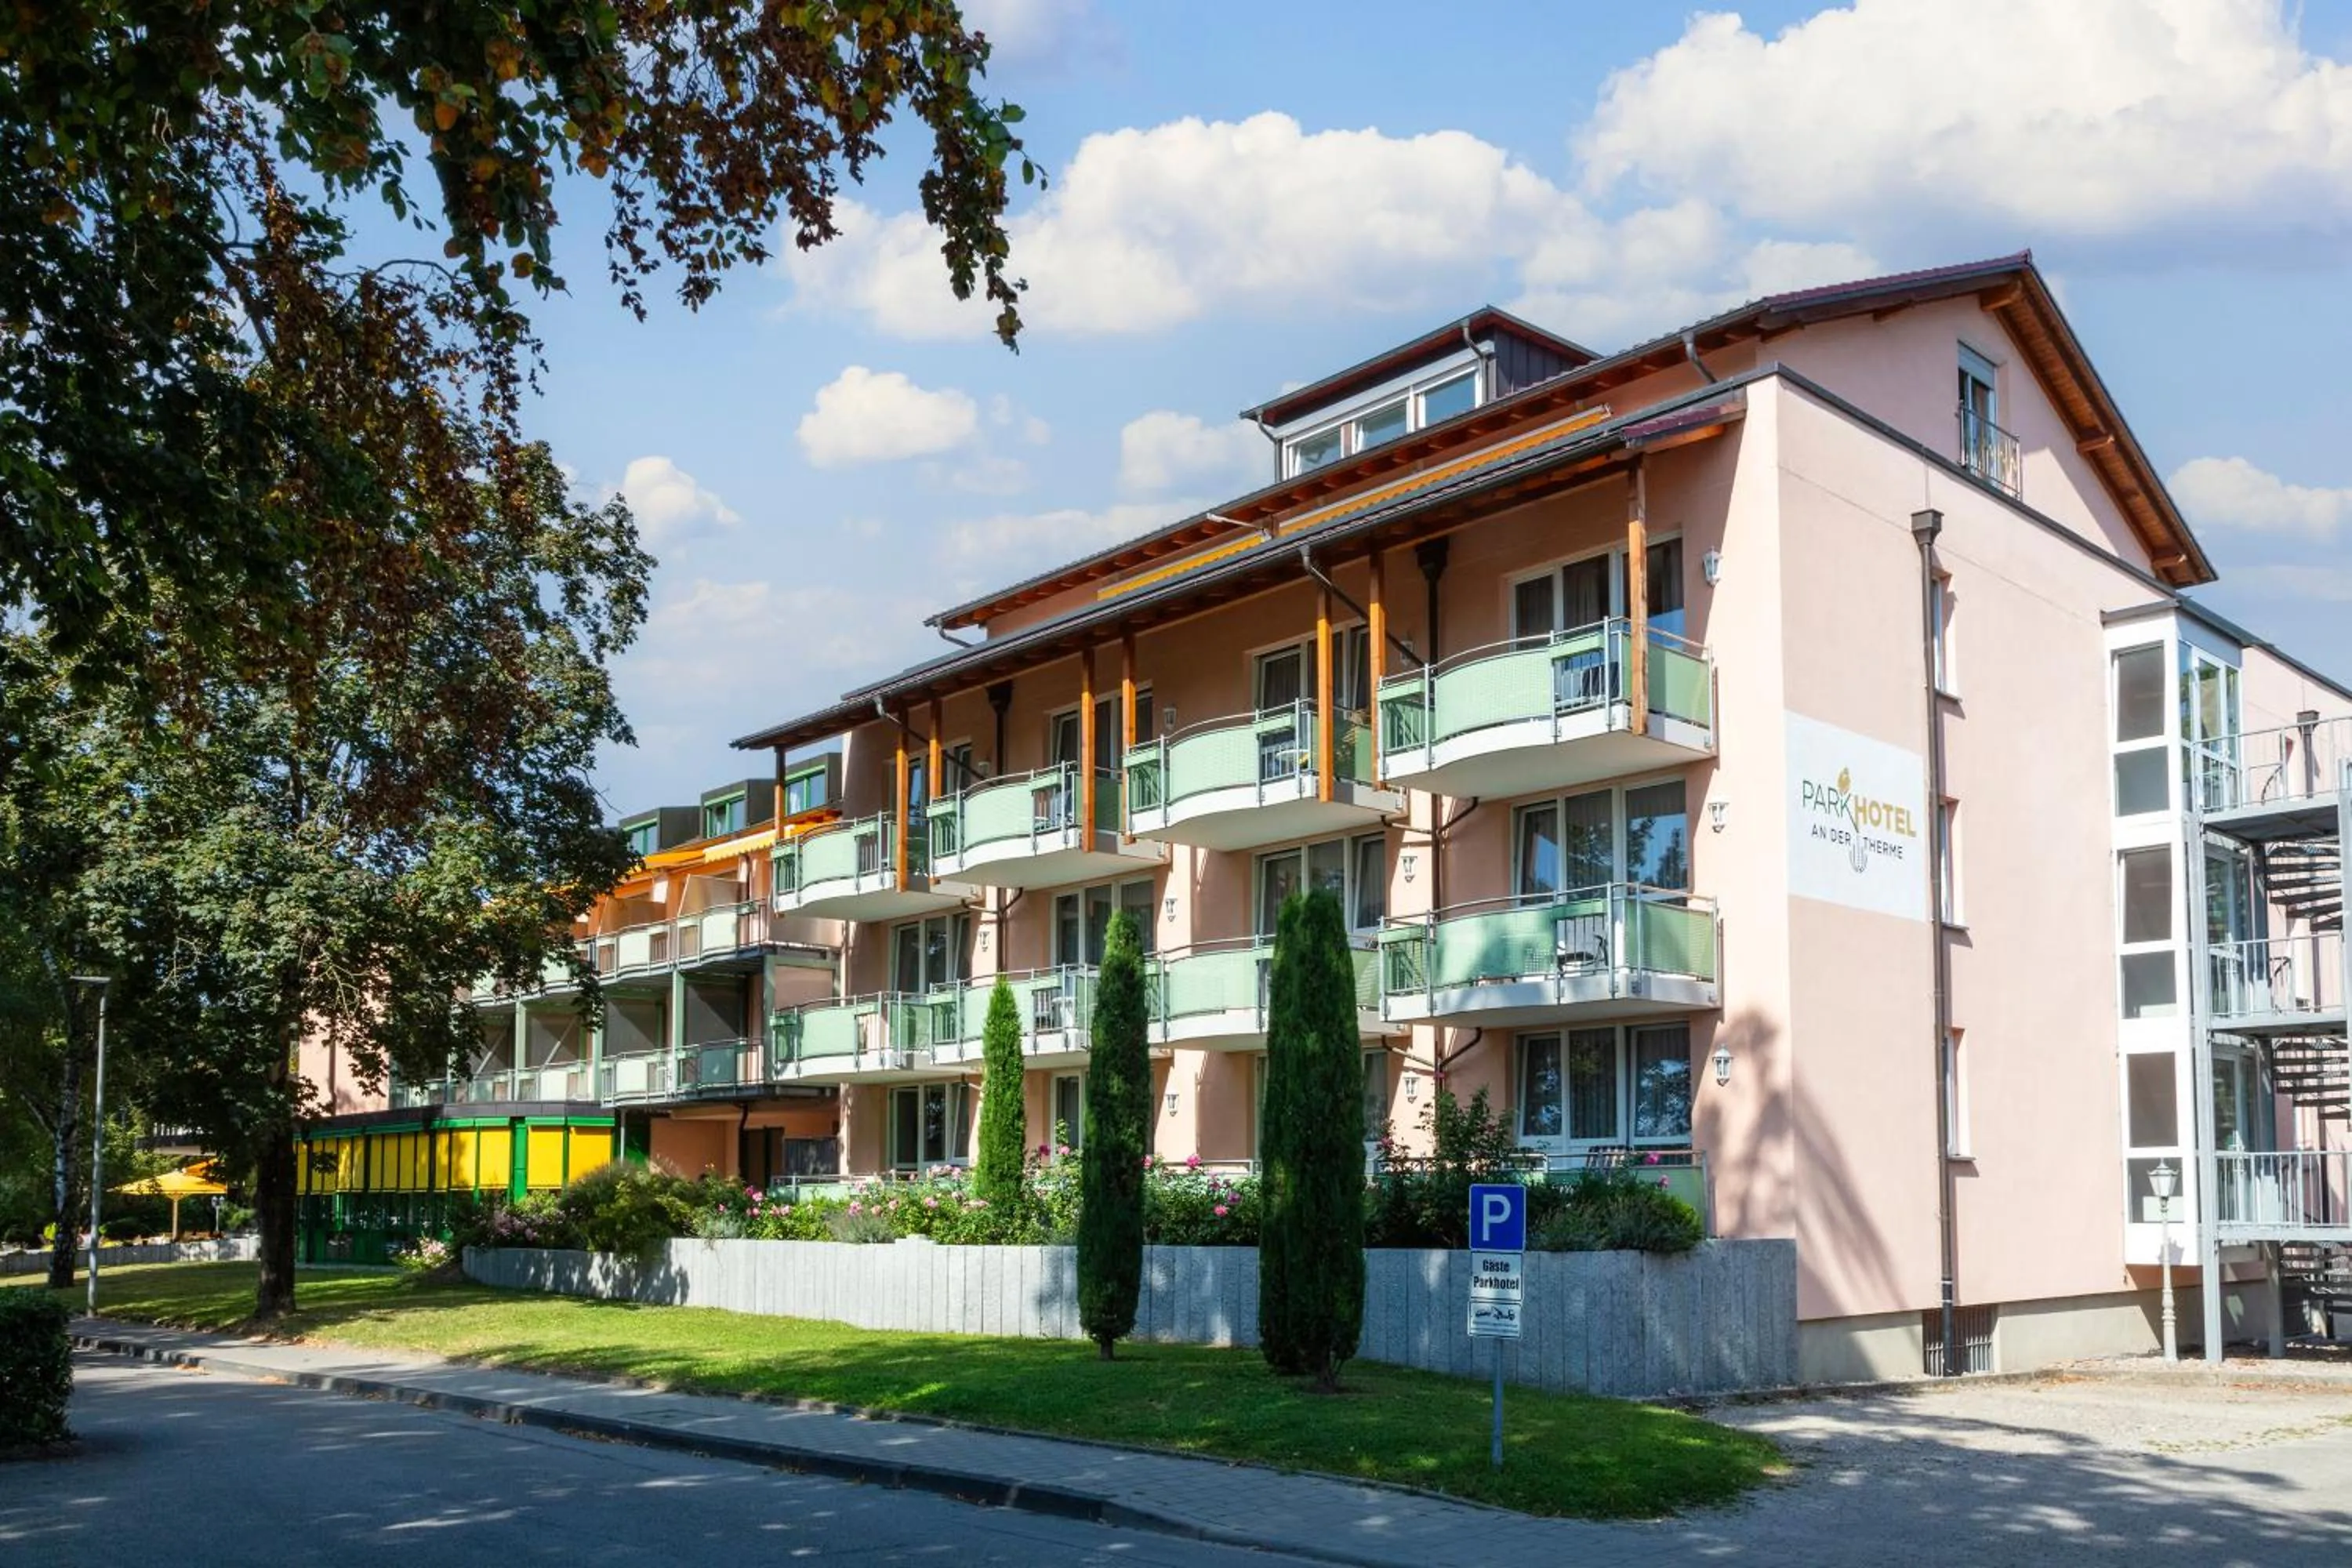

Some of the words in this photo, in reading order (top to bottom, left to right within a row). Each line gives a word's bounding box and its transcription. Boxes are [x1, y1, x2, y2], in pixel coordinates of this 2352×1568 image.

[1812, 823, 1827, 839] AN
[1831, 829, 1851, 846] DER
[1863, 837, 1904, 860] THERME
[1483, 1194, 1512, 1241] P
[1483, 1258, 1510, 1273] Gäste
[1473, 1276, 1519, 1290] Parkhotel
